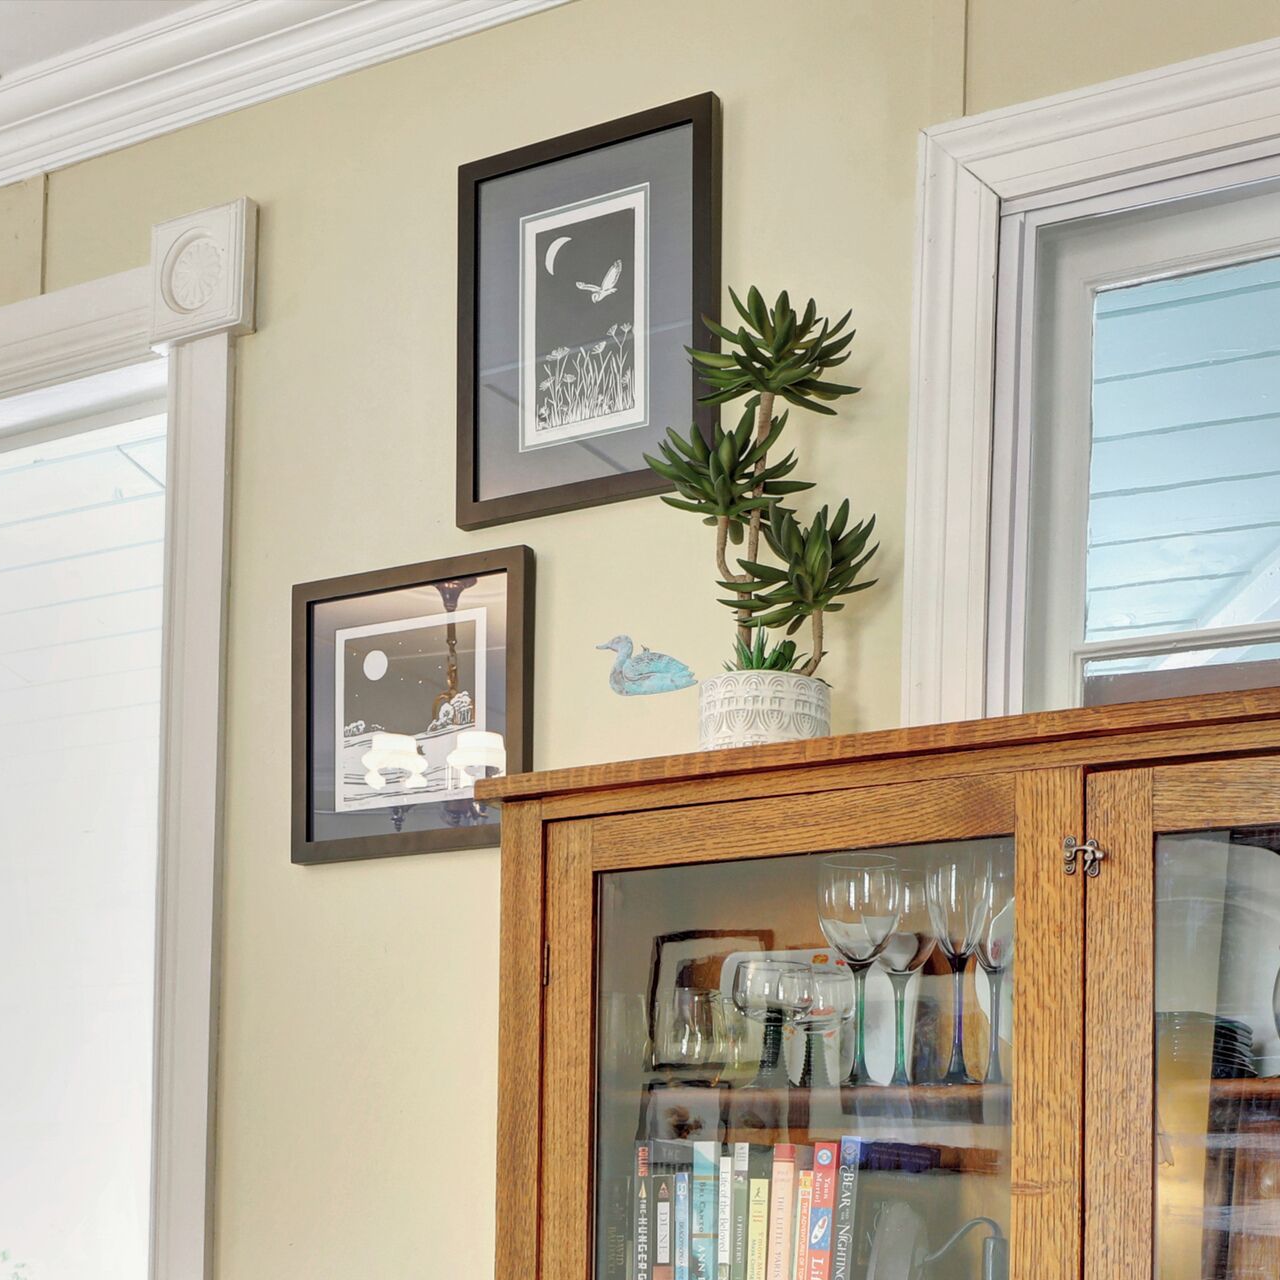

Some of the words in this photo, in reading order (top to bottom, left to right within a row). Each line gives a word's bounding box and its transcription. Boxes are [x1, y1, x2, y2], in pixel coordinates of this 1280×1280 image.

[638, 1147, 648, 1176] COLLINS
[720, 1171, 729, 1188] Life
[814, 1172, 822, 1202] Martel
[823, 1178, 831, 1199] Yann
[838, 1166, 855, 1208] BEAR
[720, 1190, 729, 1199] of
[720, 1201, 728, 1215] the
[638, 1218, 647, 1269] HUNGER
[659, 1211, 667, 1255] DUNE
[719, 1218, 728, 1253] Beloved
[775, 1217, 783, 1247] LITTLE
[774, 1252, 782, 1278] PARIS
